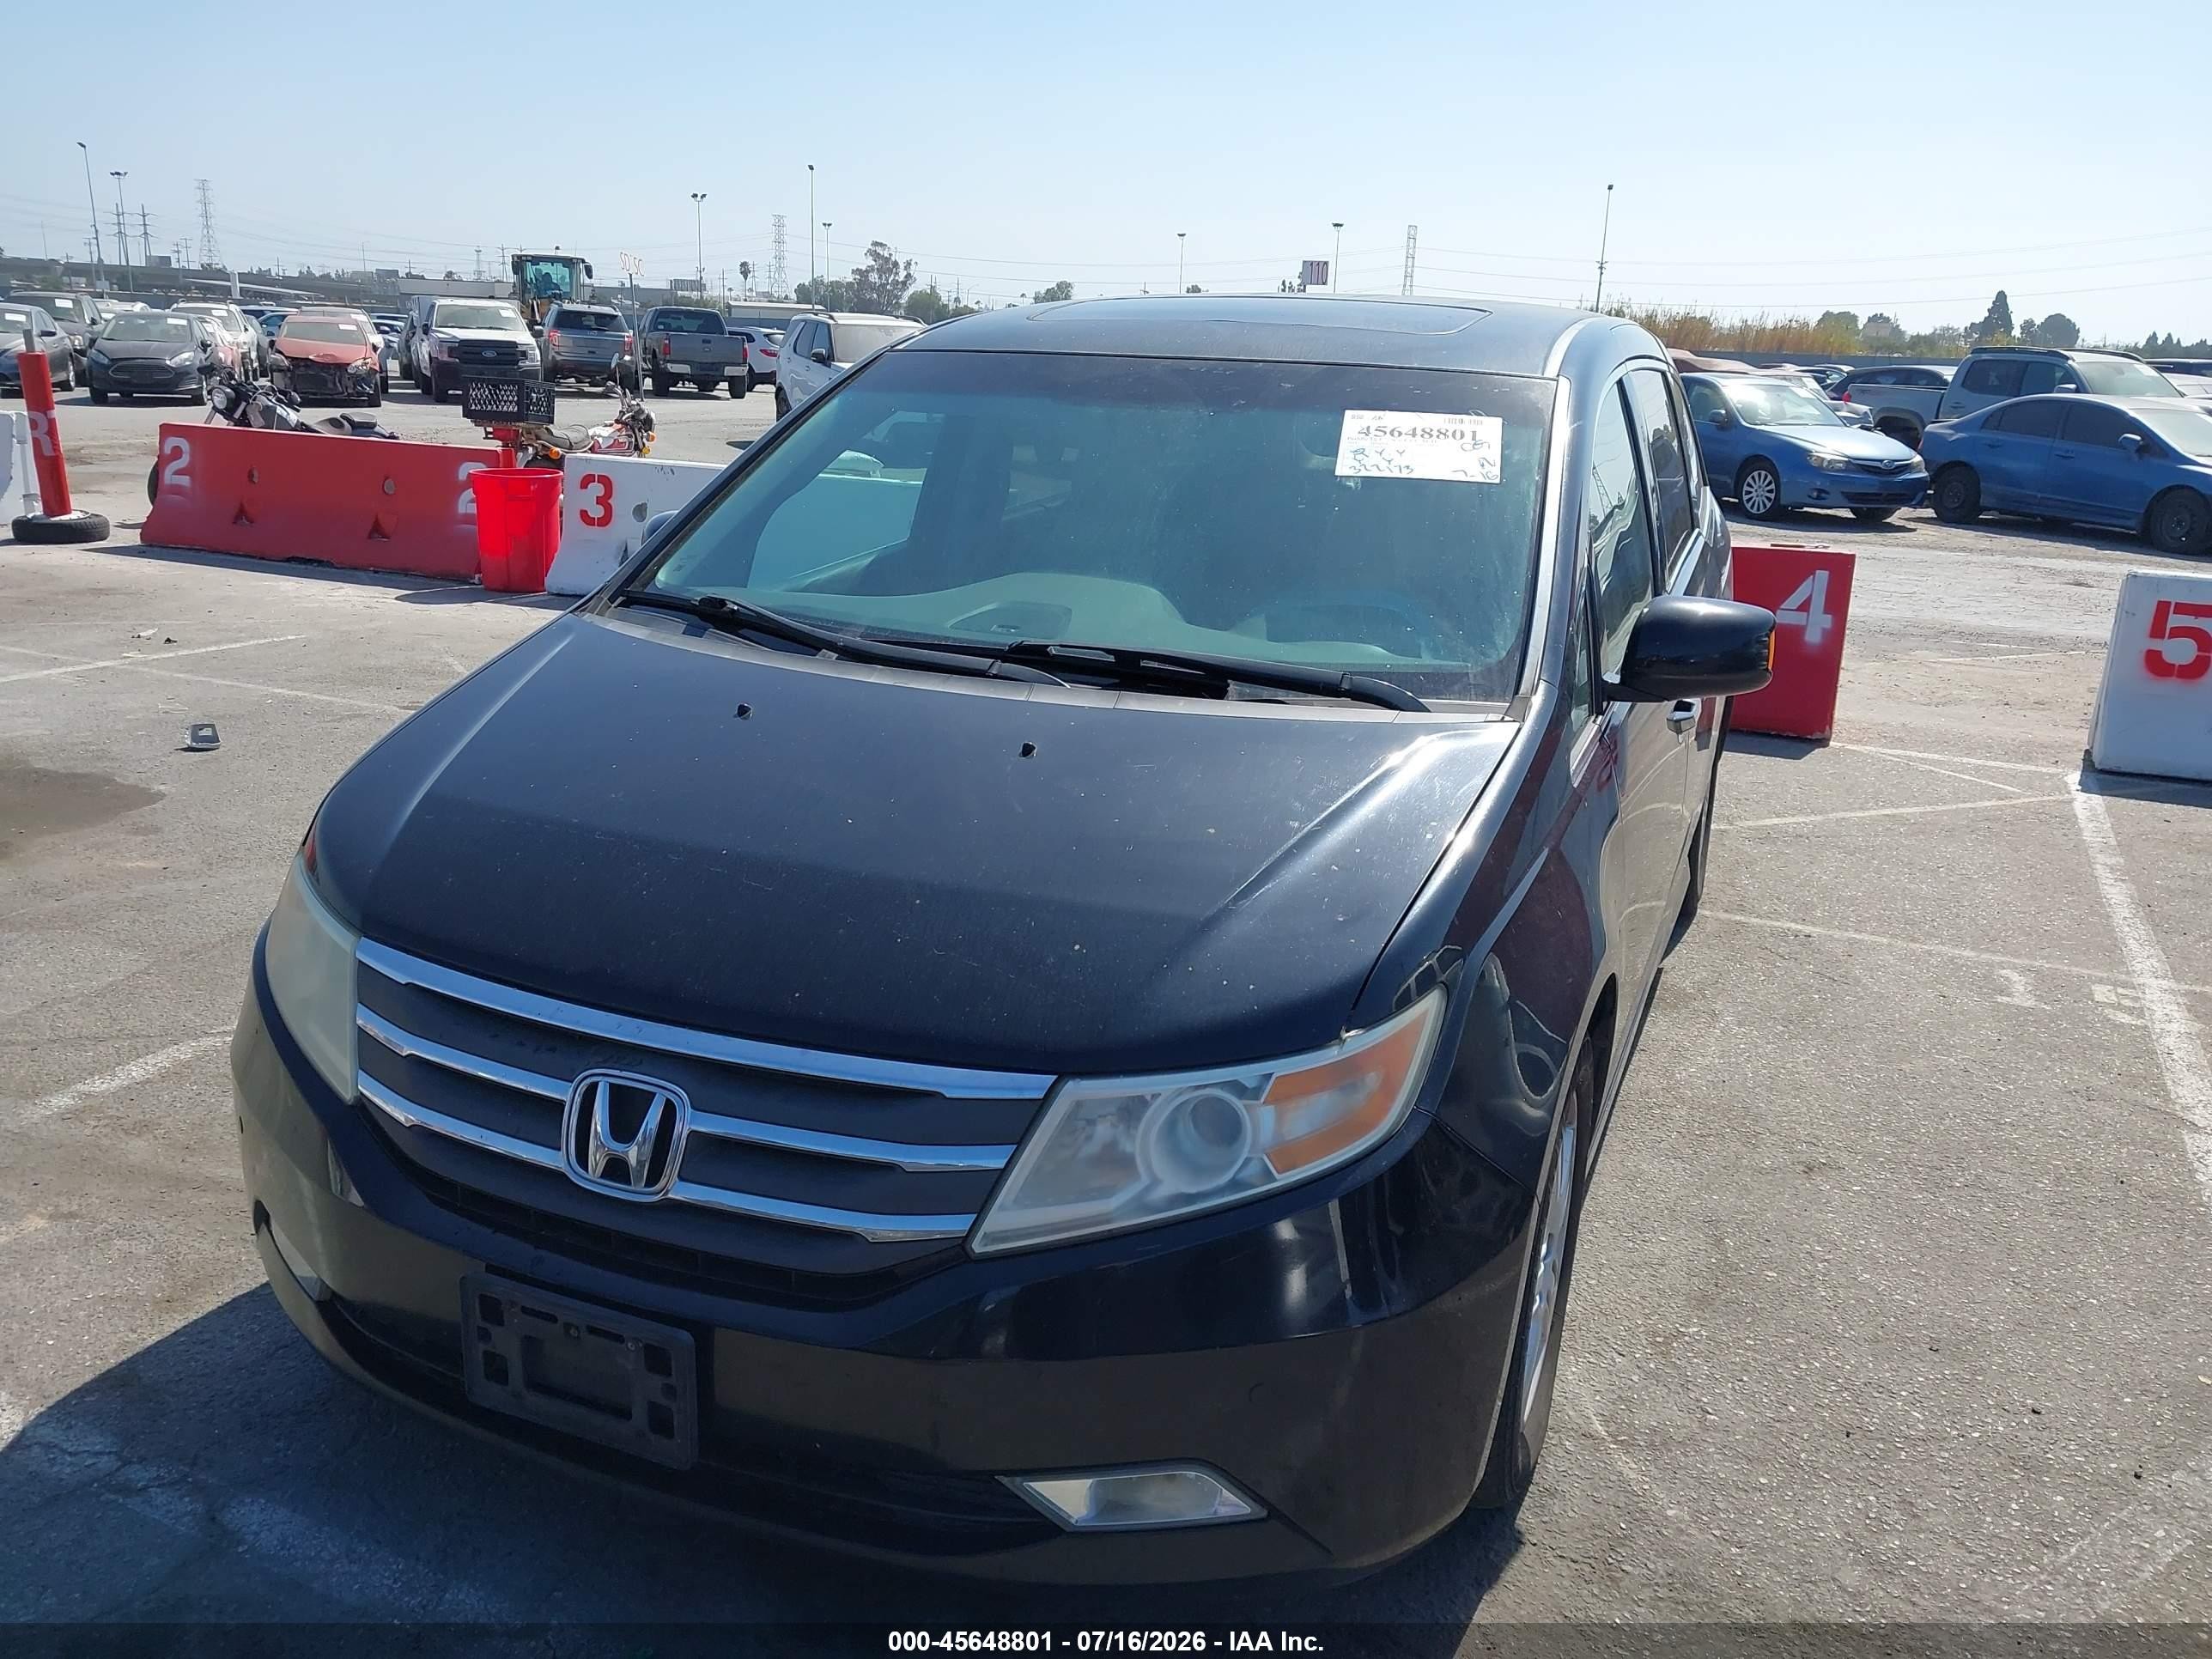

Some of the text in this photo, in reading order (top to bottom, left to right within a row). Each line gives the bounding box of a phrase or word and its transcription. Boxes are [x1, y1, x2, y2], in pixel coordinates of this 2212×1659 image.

[1357, 425, 1478, 441] 45648801
[163, 436, 191, 487] 2
[580, 473, 614, 527] 3
[1775, 570, 1832, 643] 4
[2144, 599, 2212, 680] 5
